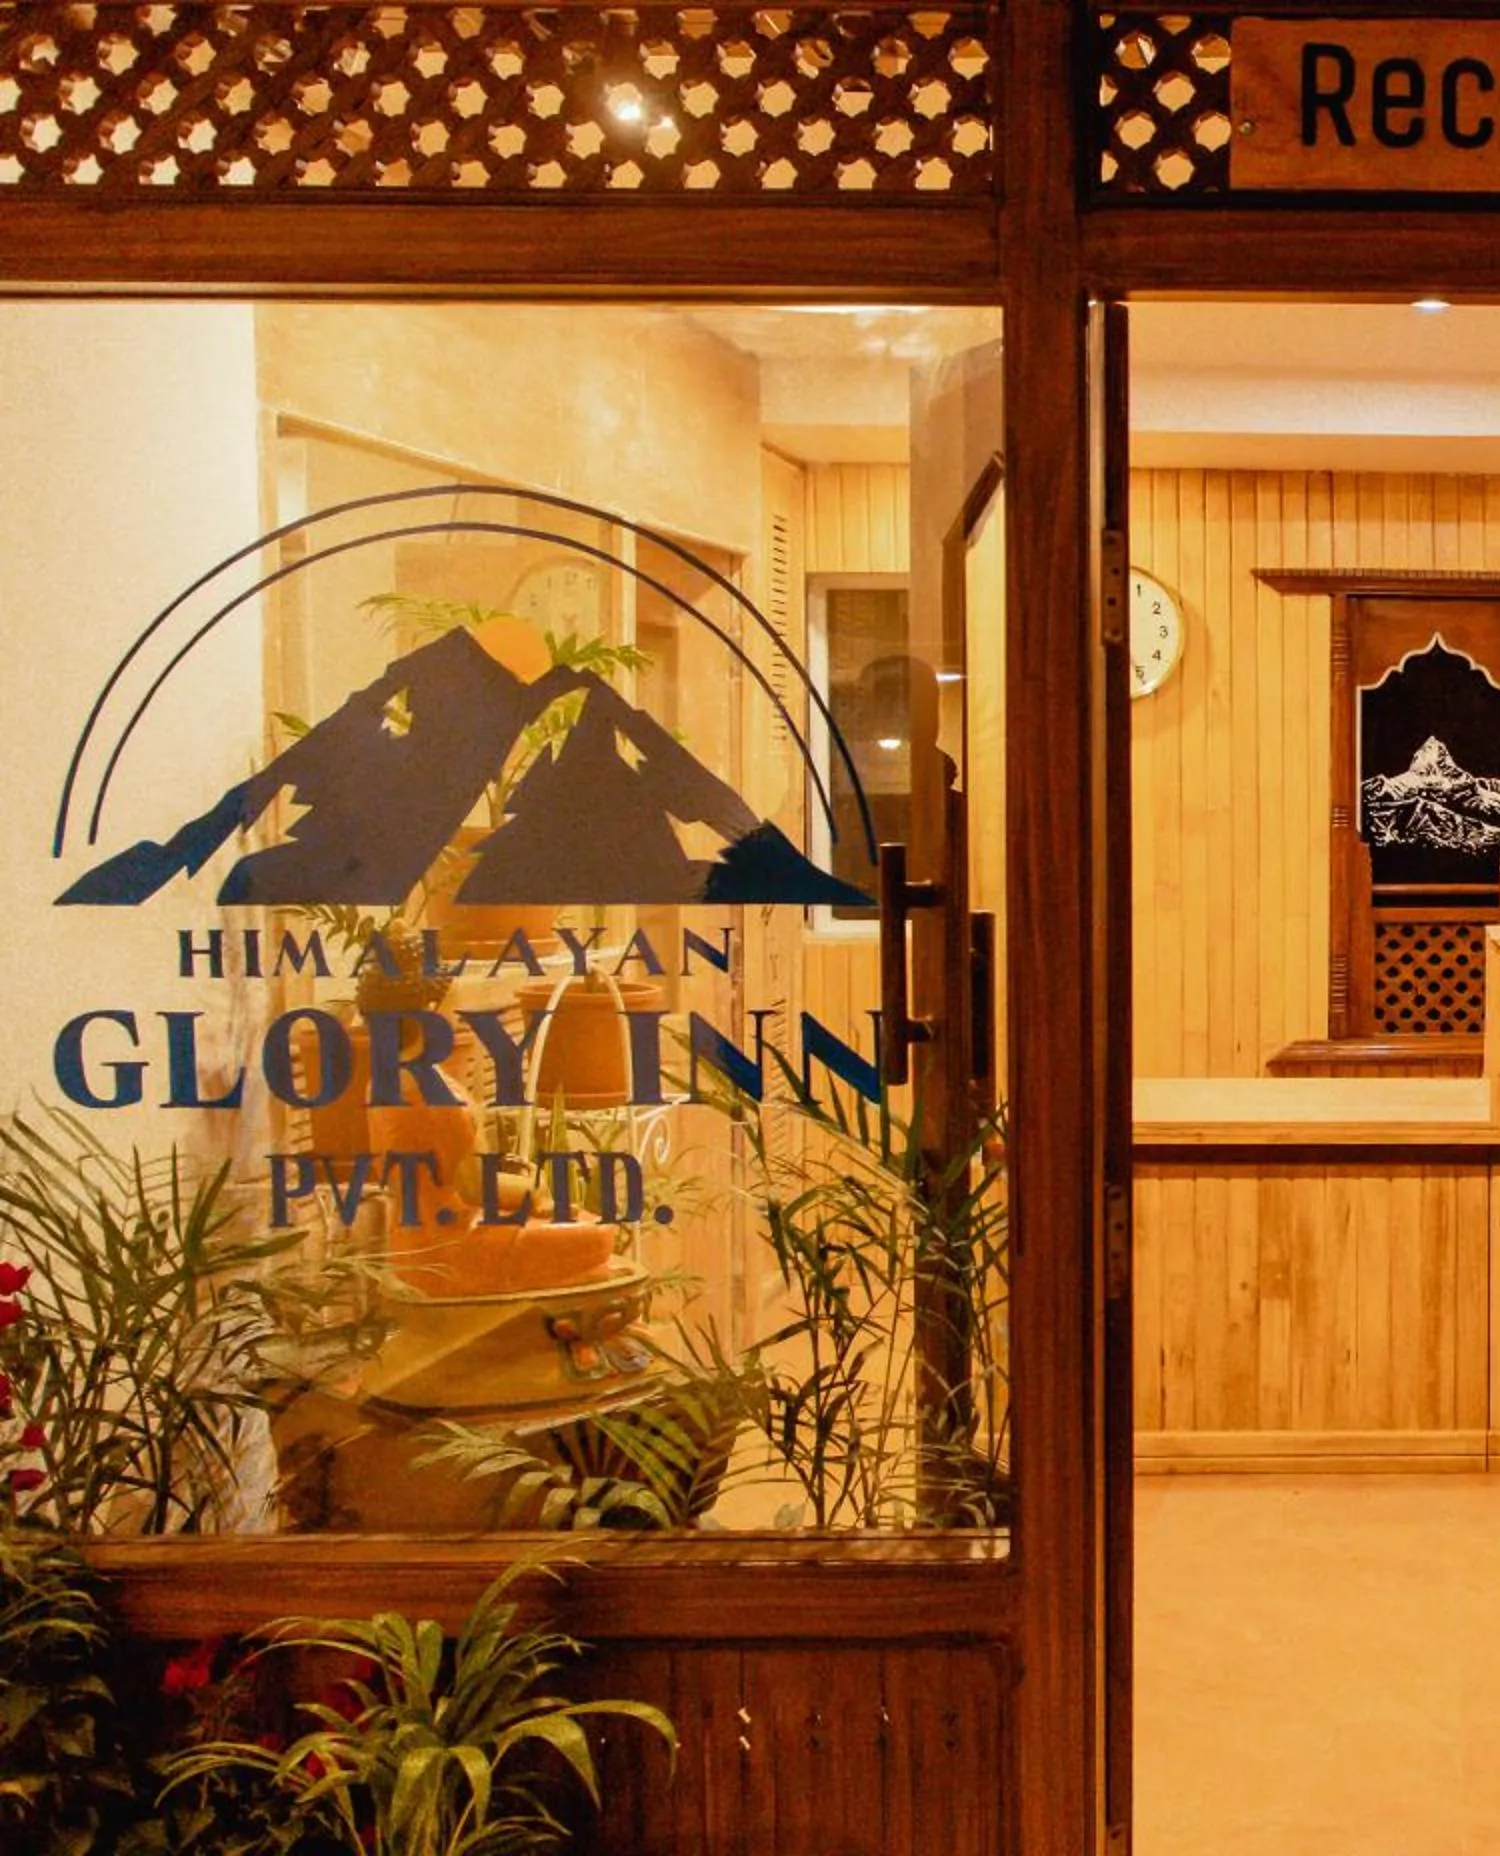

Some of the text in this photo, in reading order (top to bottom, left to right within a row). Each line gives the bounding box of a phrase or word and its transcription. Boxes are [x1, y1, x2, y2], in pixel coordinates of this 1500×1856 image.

[1152, 601, 1161, 615] 2
[1159, 625, 1169, 639] 3
[1151, 649, 1162, 661] 4
[178, 927, 734, 979] HIMALAYAN
[52, 1008, 883, 1109] GLORY INN
[264, 1152, 673, 1228] PVT. LTD.
